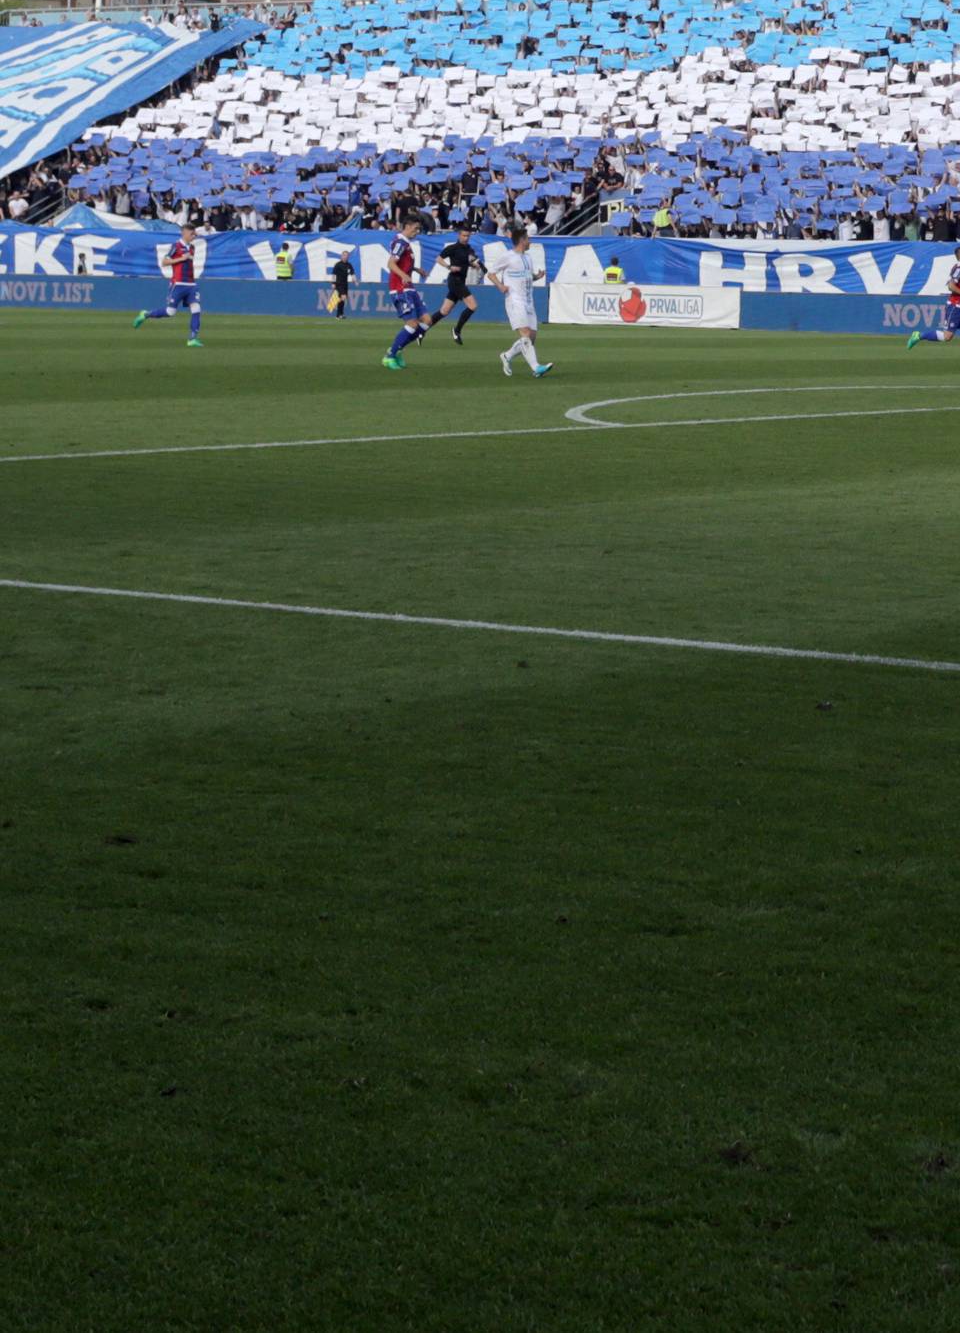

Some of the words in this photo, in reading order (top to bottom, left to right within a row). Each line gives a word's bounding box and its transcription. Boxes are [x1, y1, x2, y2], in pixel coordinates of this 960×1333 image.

[0, 232, 120, 276] KE
[1, 281, 47, 301] NOVI
[52, 282, 94, 303] LIST
[317, 289, 370, 312] NVI
[586, 297, 617, 312] MAX
